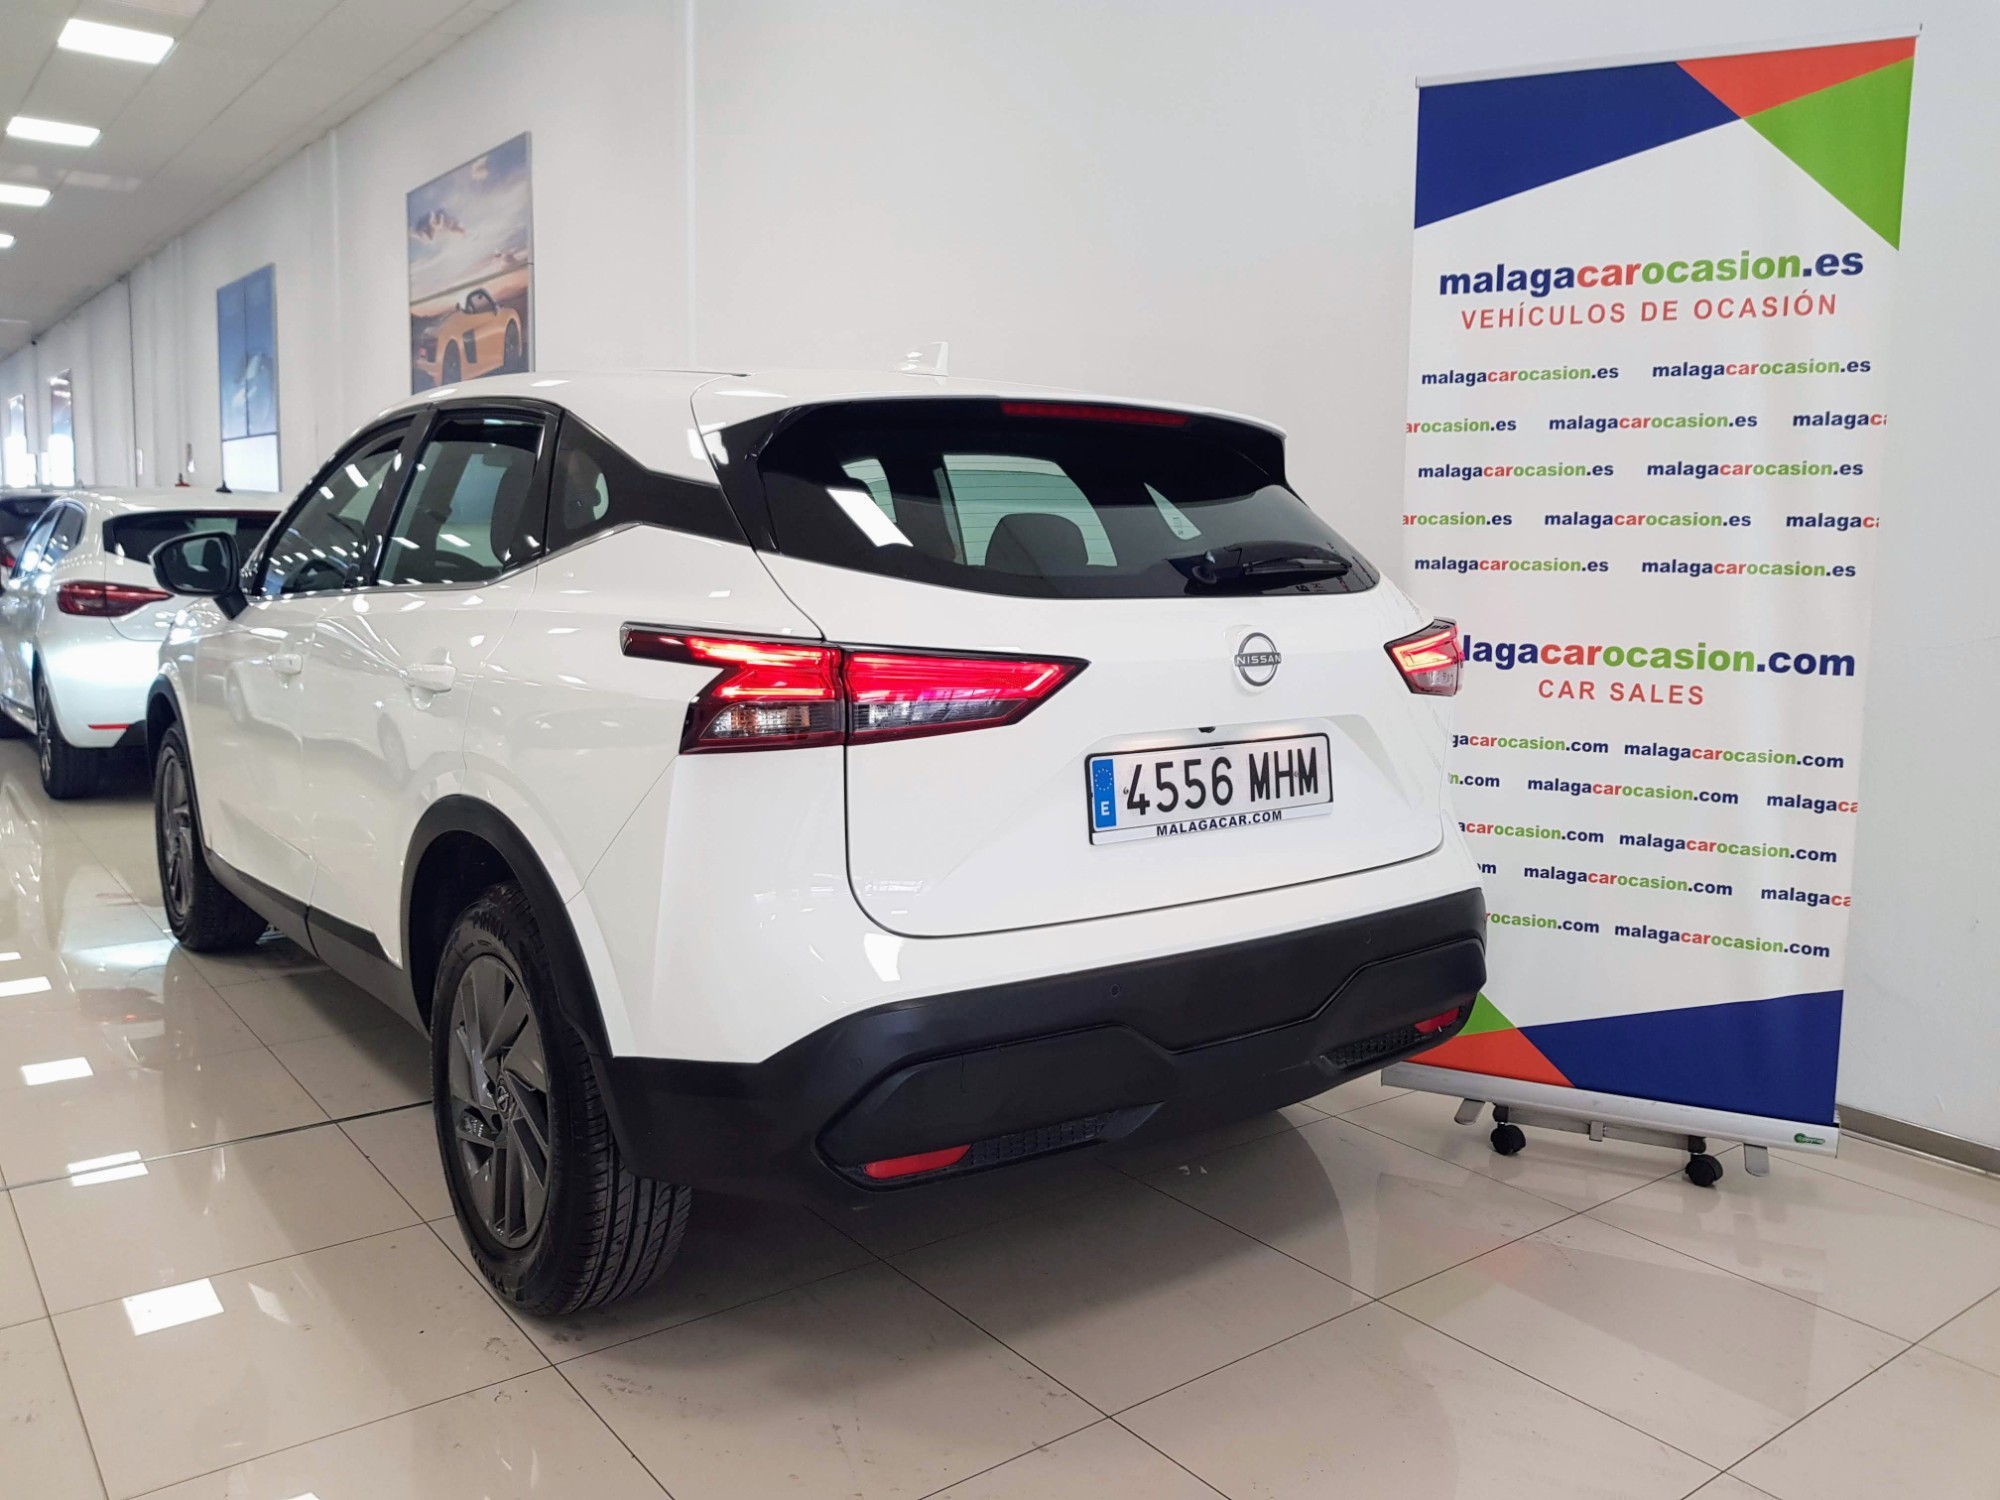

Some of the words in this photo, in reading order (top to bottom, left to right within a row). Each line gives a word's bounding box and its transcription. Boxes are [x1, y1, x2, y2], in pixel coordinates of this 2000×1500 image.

[1440, 250, 1863, 297] malagacarocasion.es
[1462, 302, 1624, 329] VEHÍCULOS
[1641, 301, 1677, 321] DE
[1694, 289, 1835, 319] OCASIÓN
[1422, 366, 1619, 387] malagacarocasion.es
[1652, 359, 1871, 380] malagacarocasion.es
[1549, 413, 1757, 433] malagacarocasion.es
[1418, 463, 1614, 481] malagacarocasion.es
[1647, 461, 1863, 479] malagacarocasion.es
[1545, 511, 1751, 529] malagacarocasion.es
[1415, 556, 1608, 574] malagacarocasion.es
[1642, 559, 1856, 577] malagacarocasion.es
[1236, 653, 1281, 664] NISSAN
[1539, 679, 1595, 700] CAR
[1610, 682, 1703, 705] SALES
[1624, 743, 1844, 768] malagacarocasion.com
[1127, 756, 1233, 815] 4556
[1249, 747, 1318, 802] MHM
[1528, 778, 1738, 804] malagacarocasion.com
[1101, 801, 1110, 816] E
[1156, 810, 1282, 836] MALAGACAR.COM
[1620, 833, 1837, 862] malagacarocasion.com
[1524, 866, 1732, 896] malagacarocasion.com
[1615, 925, 1830, 958] malagacarocasion.com
